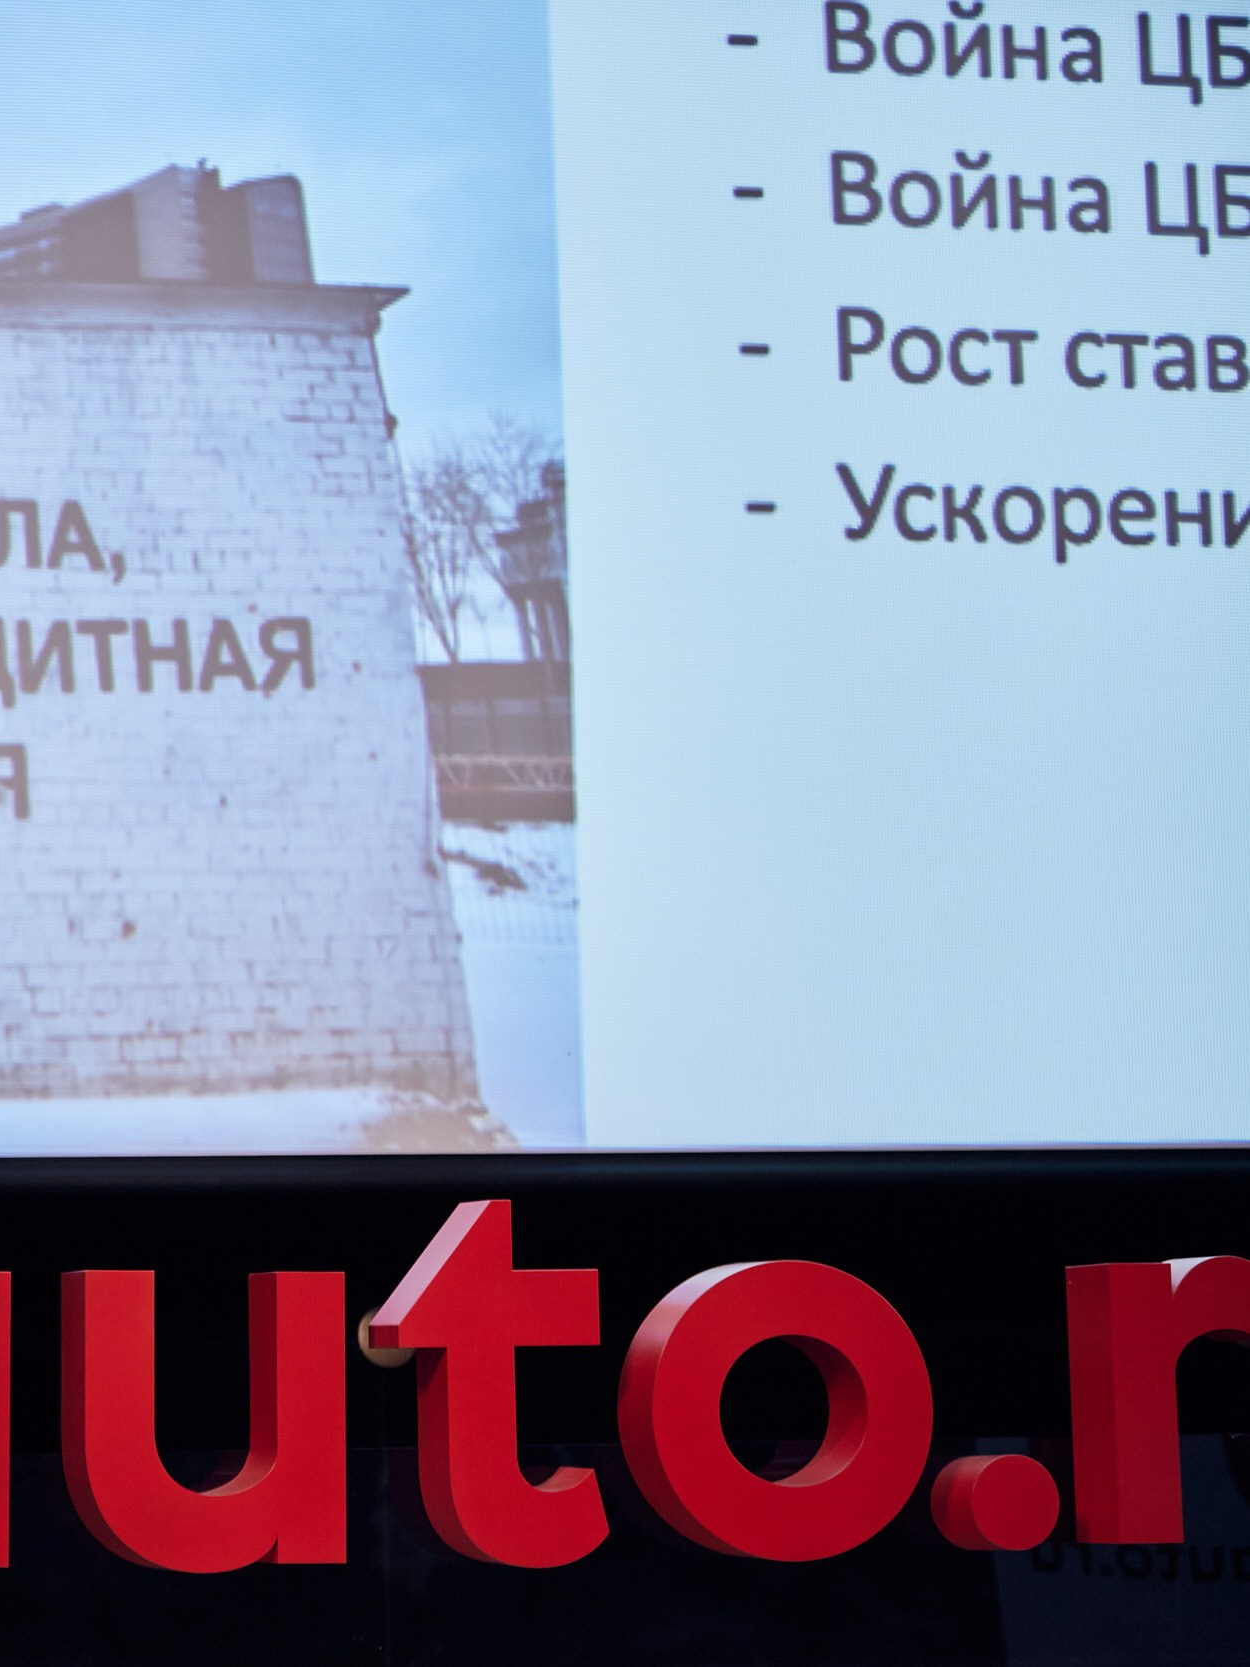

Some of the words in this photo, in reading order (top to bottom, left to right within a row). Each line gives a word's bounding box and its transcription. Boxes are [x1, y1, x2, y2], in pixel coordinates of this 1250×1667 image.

[823, 0, 1104, 84] Война
[1136, 11, 1250, 106] ЦБ
[830, 150, 1111, 234] Война
[1144, 160, 1250, 257] ЦБ
[836, 306, 1039, 386] Рост
[1064, 331, 1250, 393] став
